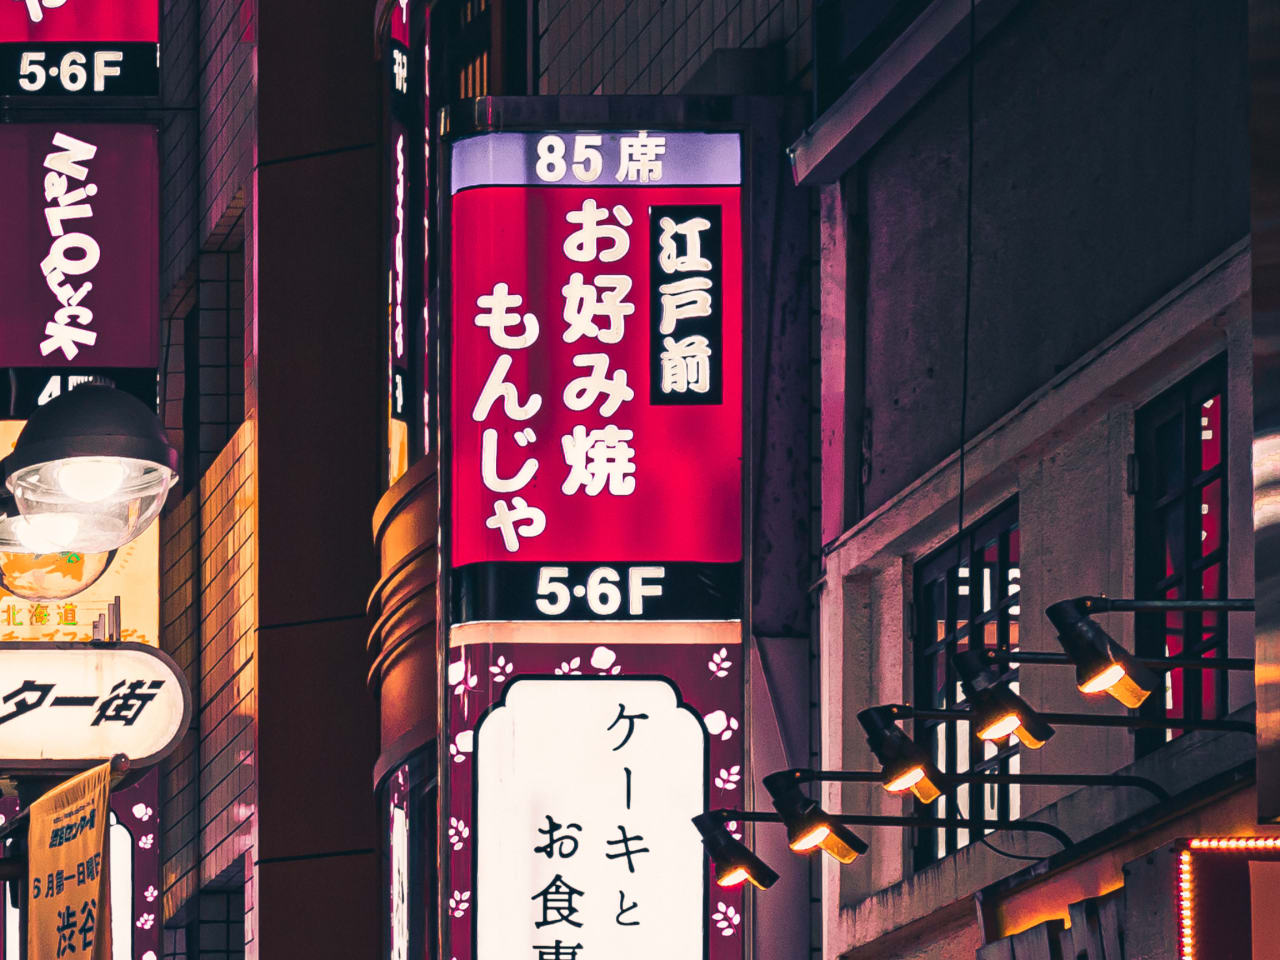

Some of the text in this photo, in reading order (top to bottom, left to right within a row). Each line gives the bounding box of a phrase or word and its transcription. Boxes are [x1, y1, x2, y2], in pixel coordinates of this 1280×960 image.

[536, 134, 667, 183] 85席
[471, 282, 547, 553] もんじゃ
[561, 198, 637, 496] お好み焼
[658, 215, 713, 395] 江戸前
[605, 702, 650, 927] ケーキと
